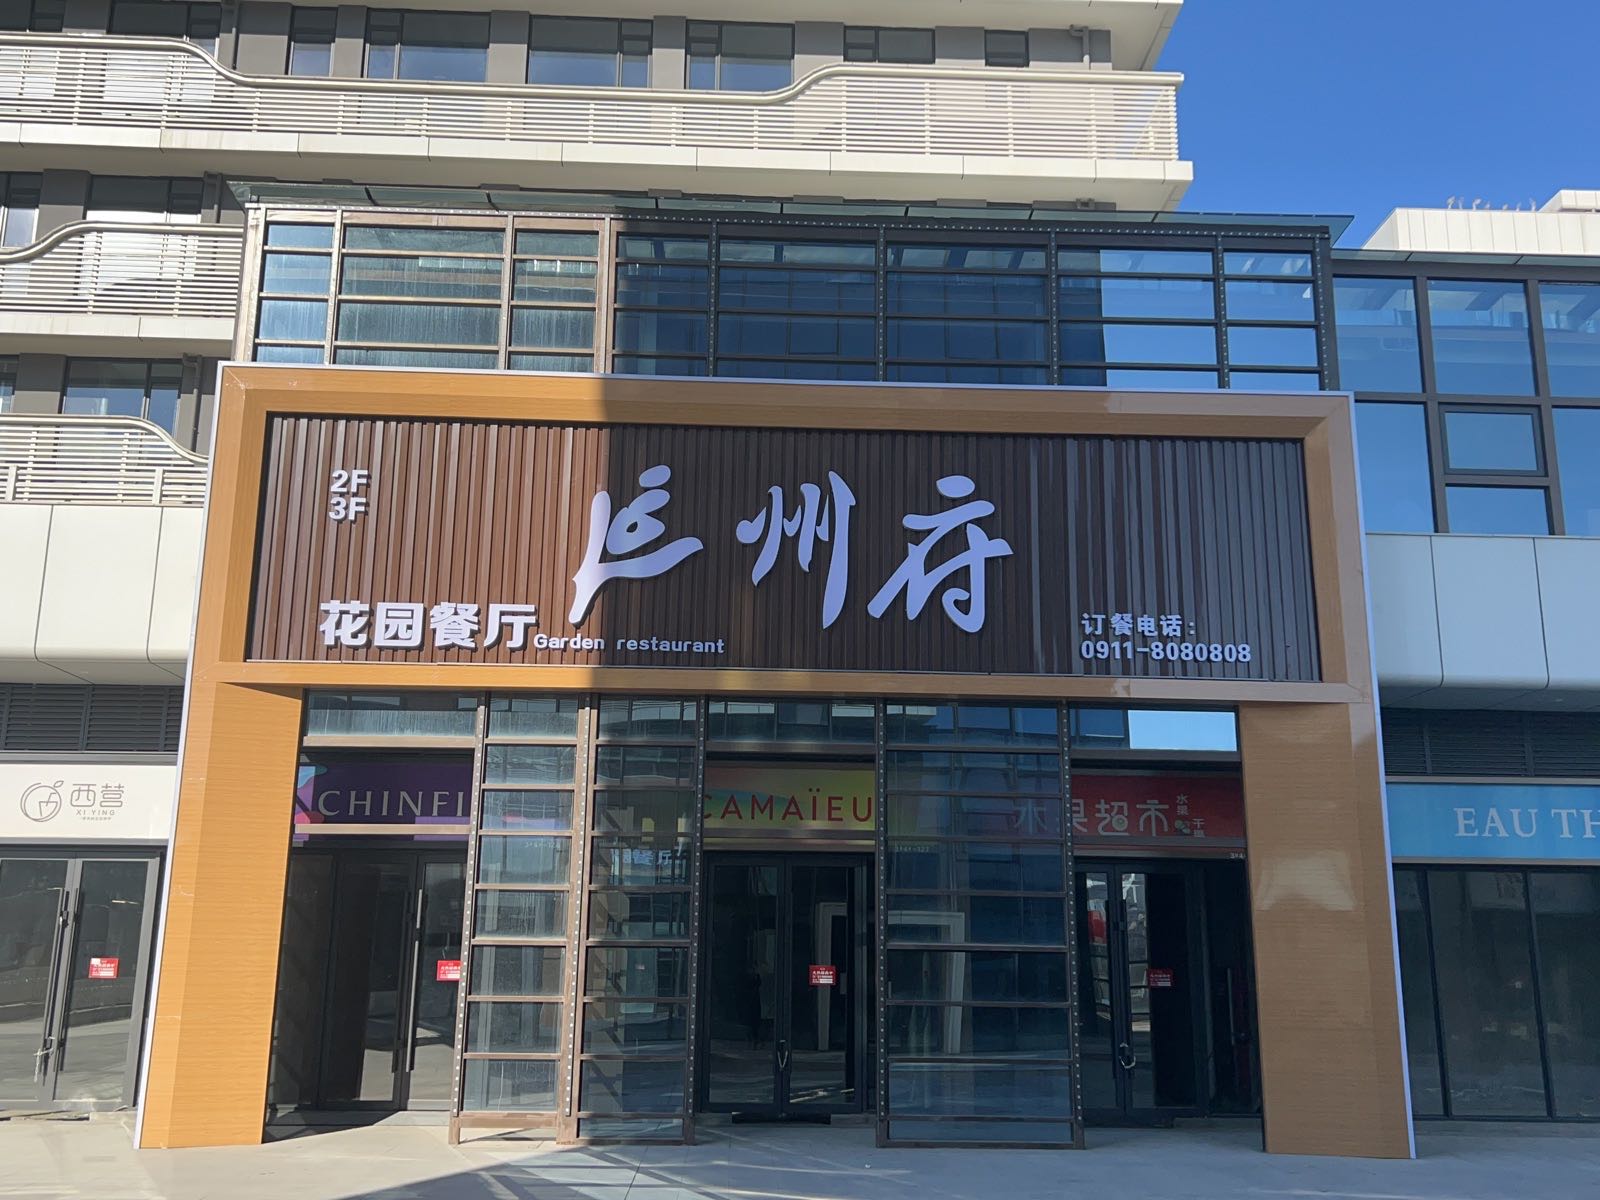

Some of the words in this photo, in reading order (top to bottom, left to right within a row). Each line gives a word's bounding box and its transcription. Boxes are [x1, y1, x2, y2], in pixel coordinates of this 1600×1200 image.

[330, 469, 370, 494] 2F
[328, 497, 369, 521] 3F
[568, 465, 1013, 634] 延州府
[319, 600, 537, 650] 花园餐厅
[533, 634, 605, 651] Garden
[616, 638, 725, 654] restaurant
[1081, 641, 1252, 663] 0911-8080808
[76, 809, 87, 817] XI
[91, 809, 115, 817] YING
[1454, 807, 1539, 838] EAU
